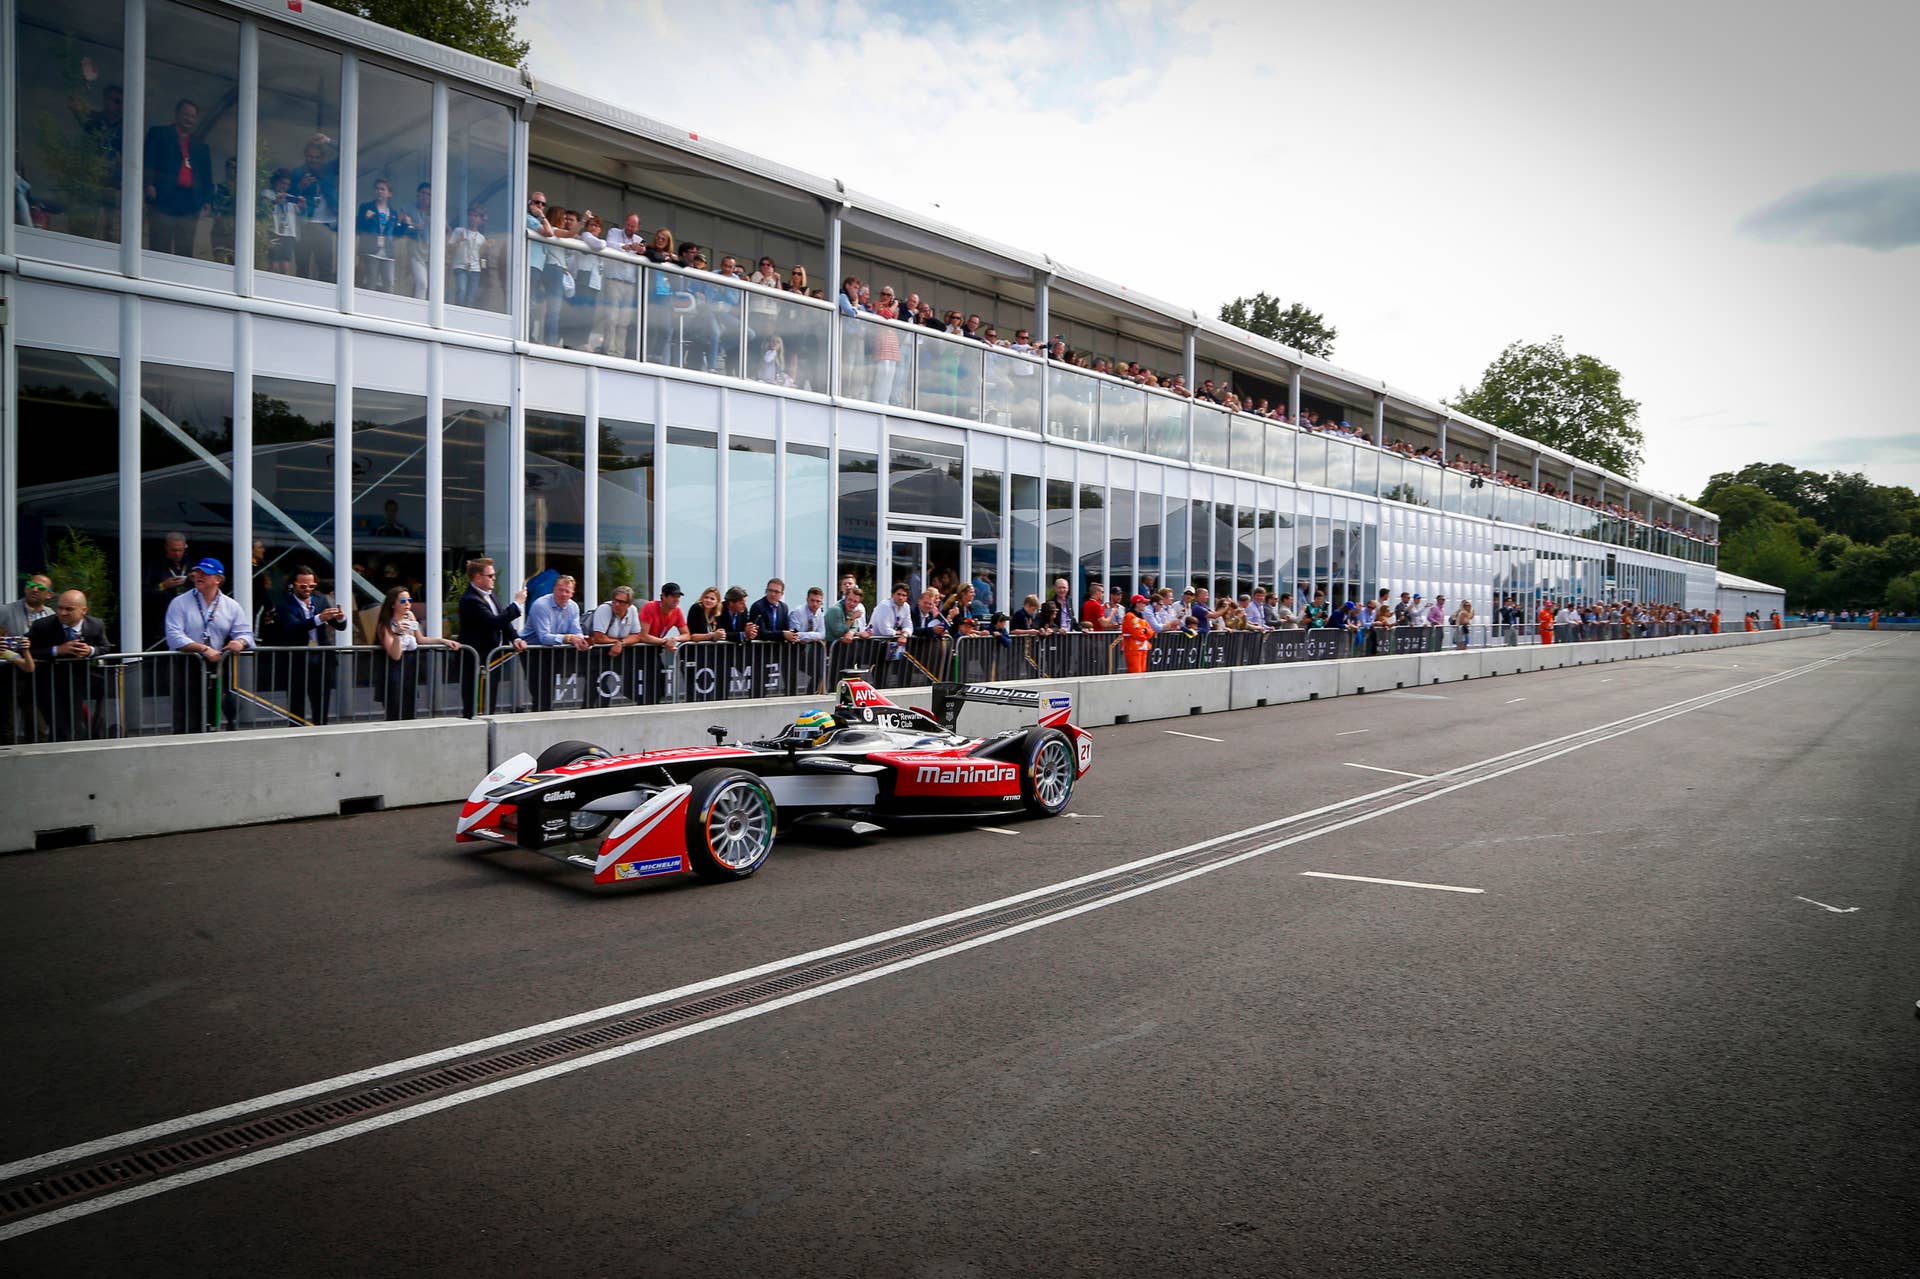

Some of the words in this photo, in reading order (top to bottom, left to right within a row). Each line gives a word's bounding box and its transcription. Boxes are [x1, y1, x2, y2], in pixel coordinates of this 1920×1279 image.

[855, 689, 877, 701] AVIS
[967, 686, 1040, 699] Mahind
[877, 713, 900, 729] IHG
[900, 720, 913, 728] Club
[1080, 743, 1091, 761] 21
[916, 764, 1016, 784] Mahindra
[543, 790, 576, 802] Gillette
[640, 860, 681, 871] MICHELIN
